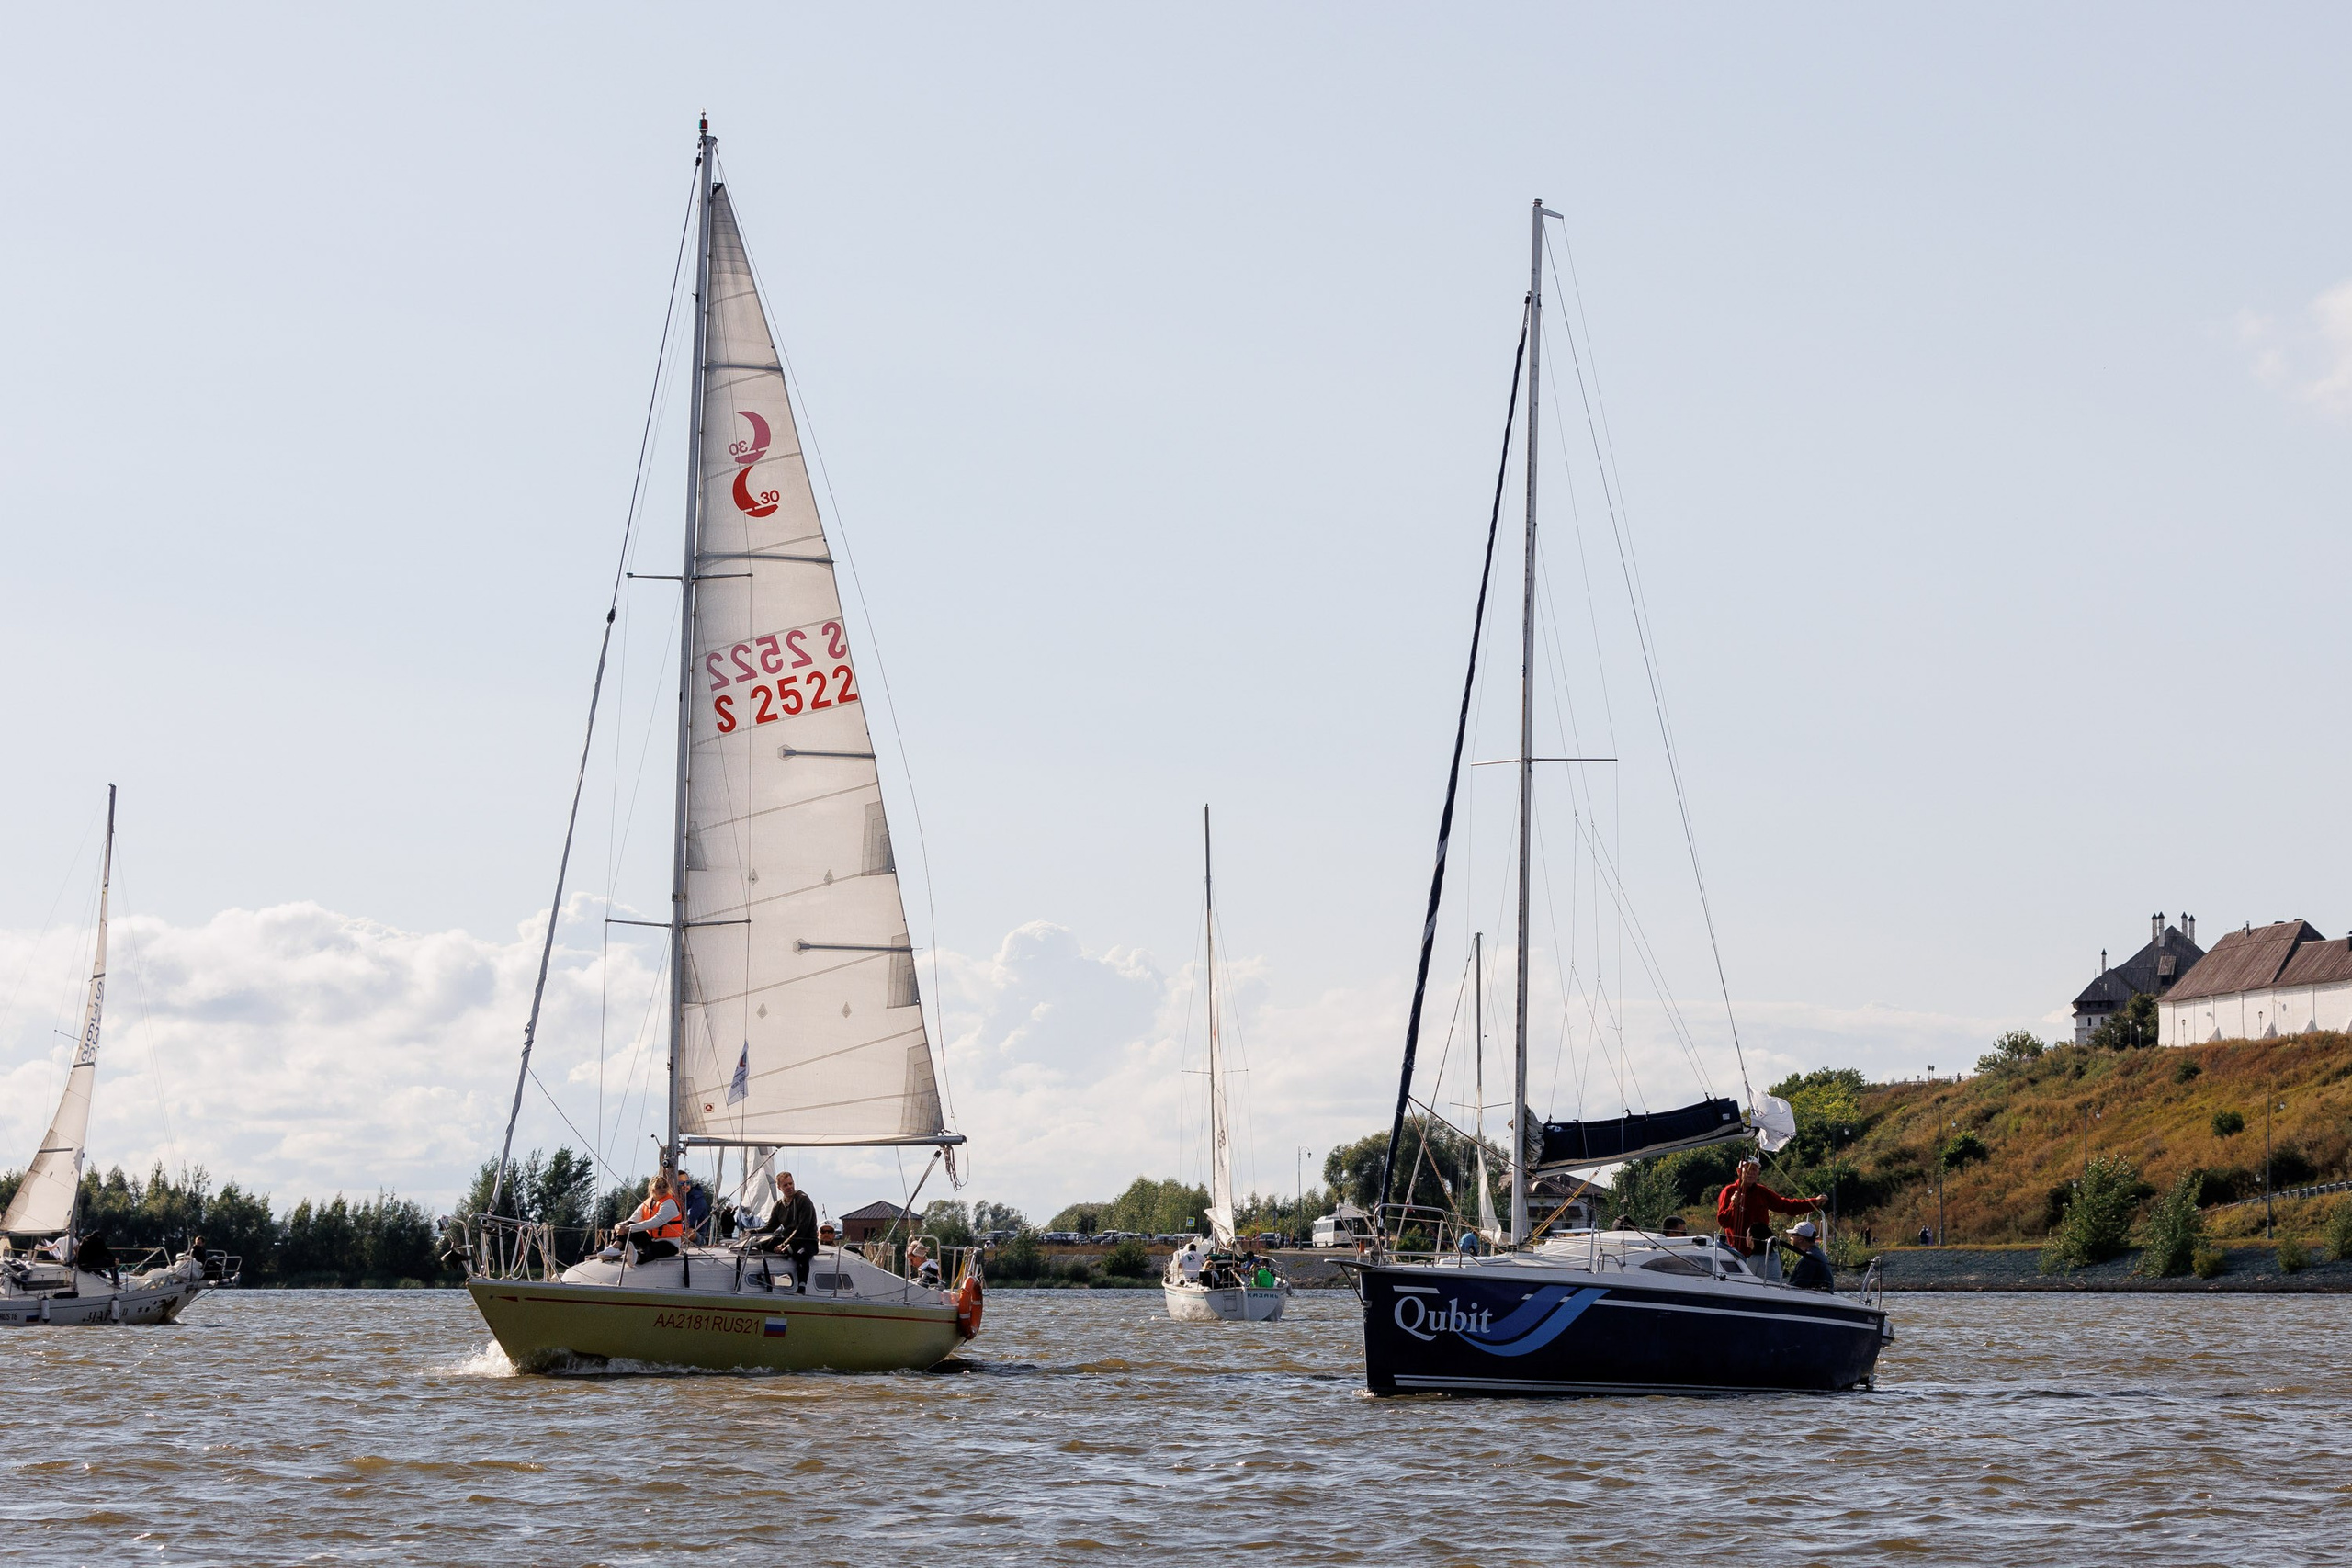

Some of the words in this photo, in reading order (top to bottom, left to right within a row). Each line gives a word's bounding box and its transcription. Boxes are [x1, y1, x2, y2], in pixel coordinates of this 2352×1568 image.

[760, 490, 780, 504] 30
[714, 694, 737, 733] S
[750, 664, 859, 725] 2522
[653, 1313, 761, 1335] AA2181RUS21
[1394, 1295, 1493, 1341] Qubit
